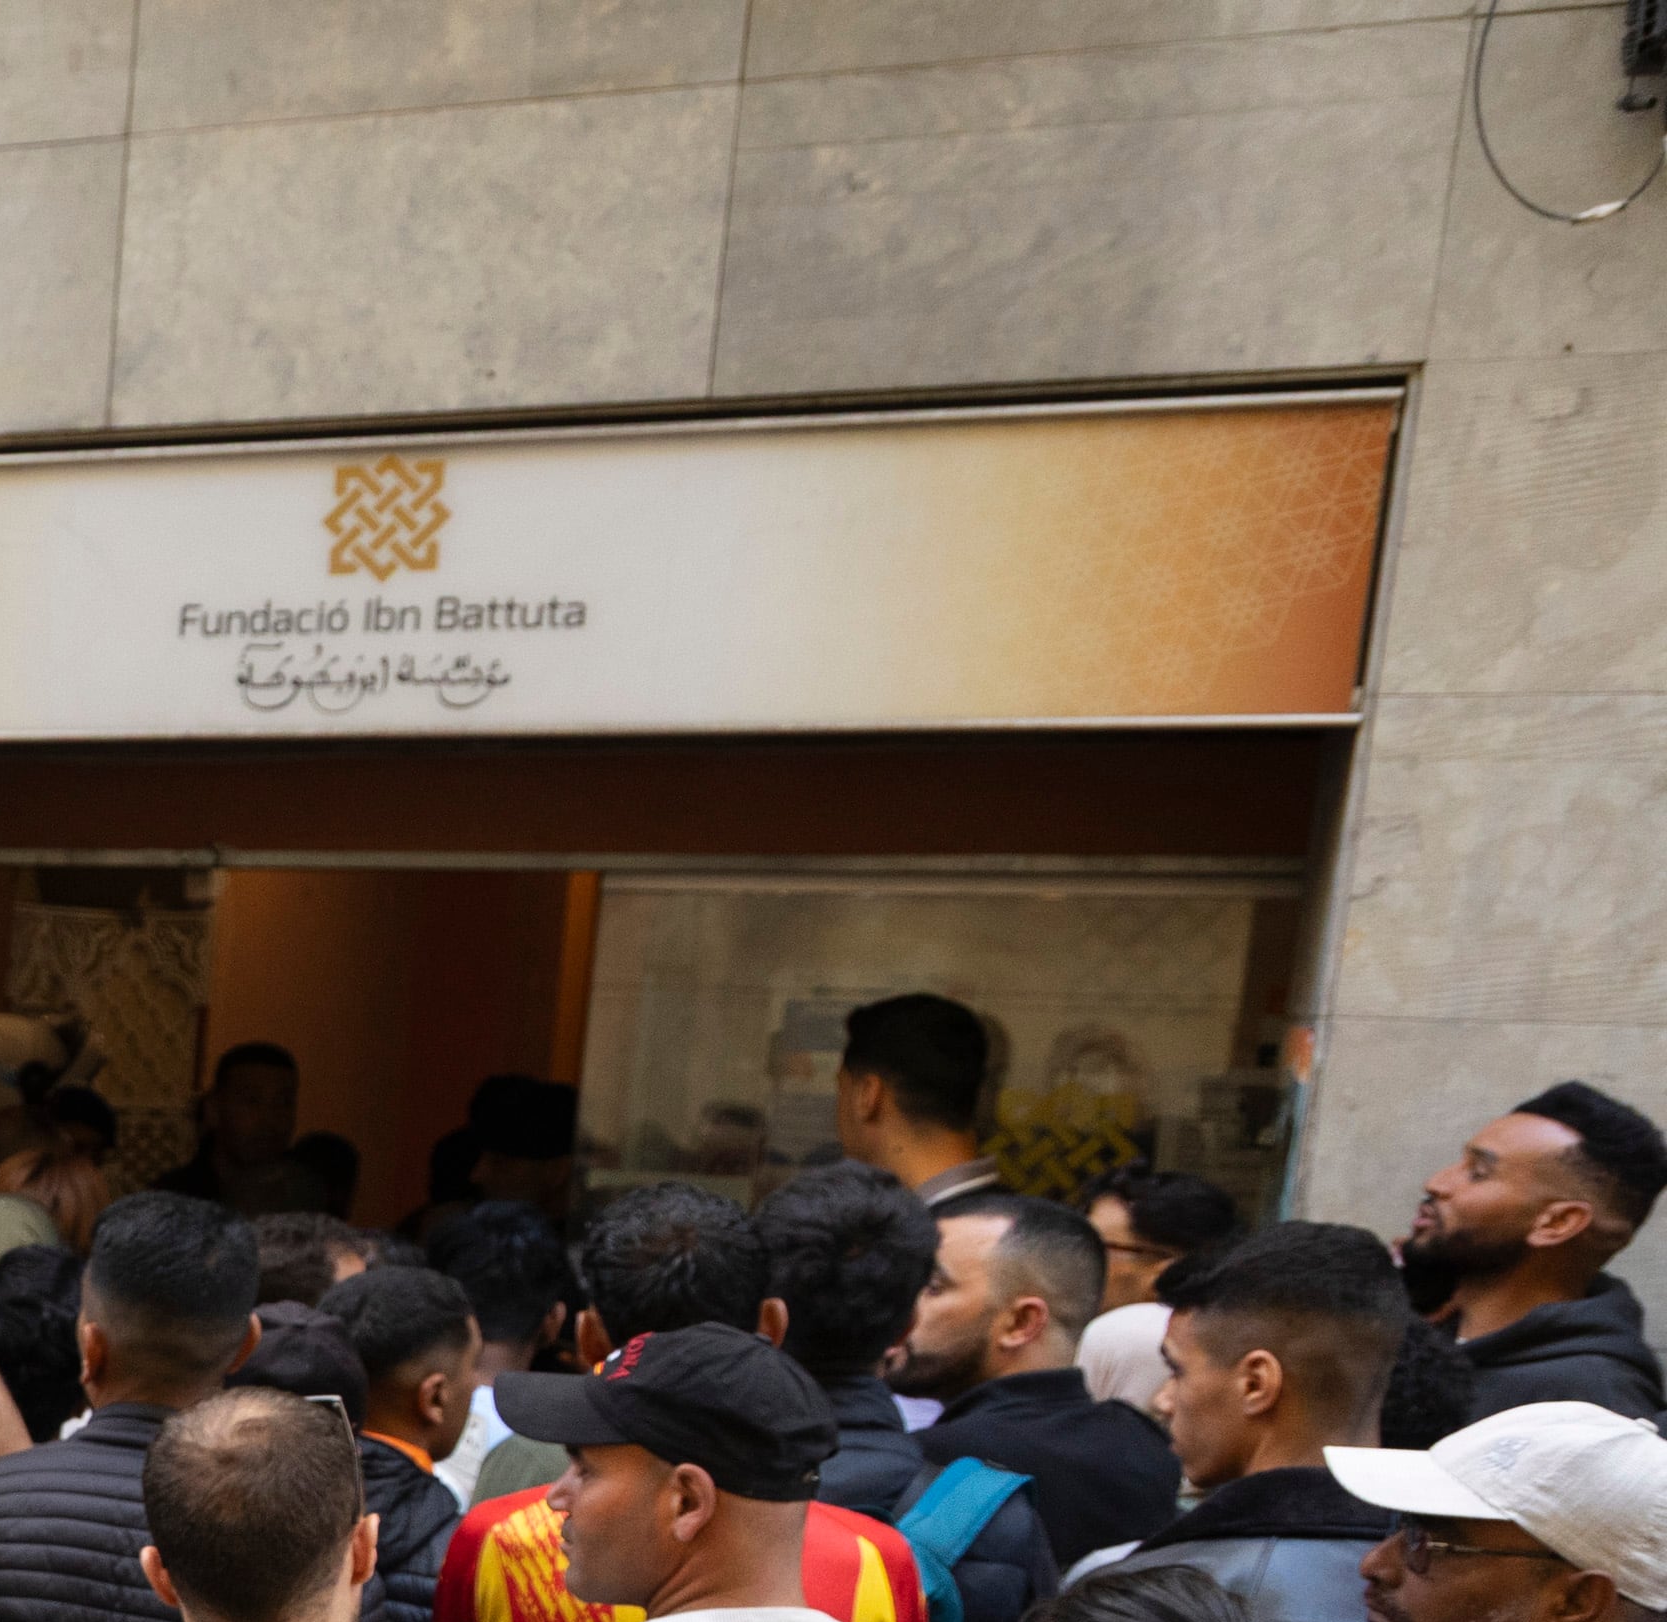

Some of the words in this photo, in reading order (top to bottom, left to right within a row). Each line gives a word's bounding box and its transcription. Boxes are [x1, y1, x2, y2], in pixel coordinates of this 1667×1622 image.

[178, 600, 351, 637] Fundació
[363, 597, 421, 633] Ibn
[435, 594, 587, 631] Battuta
